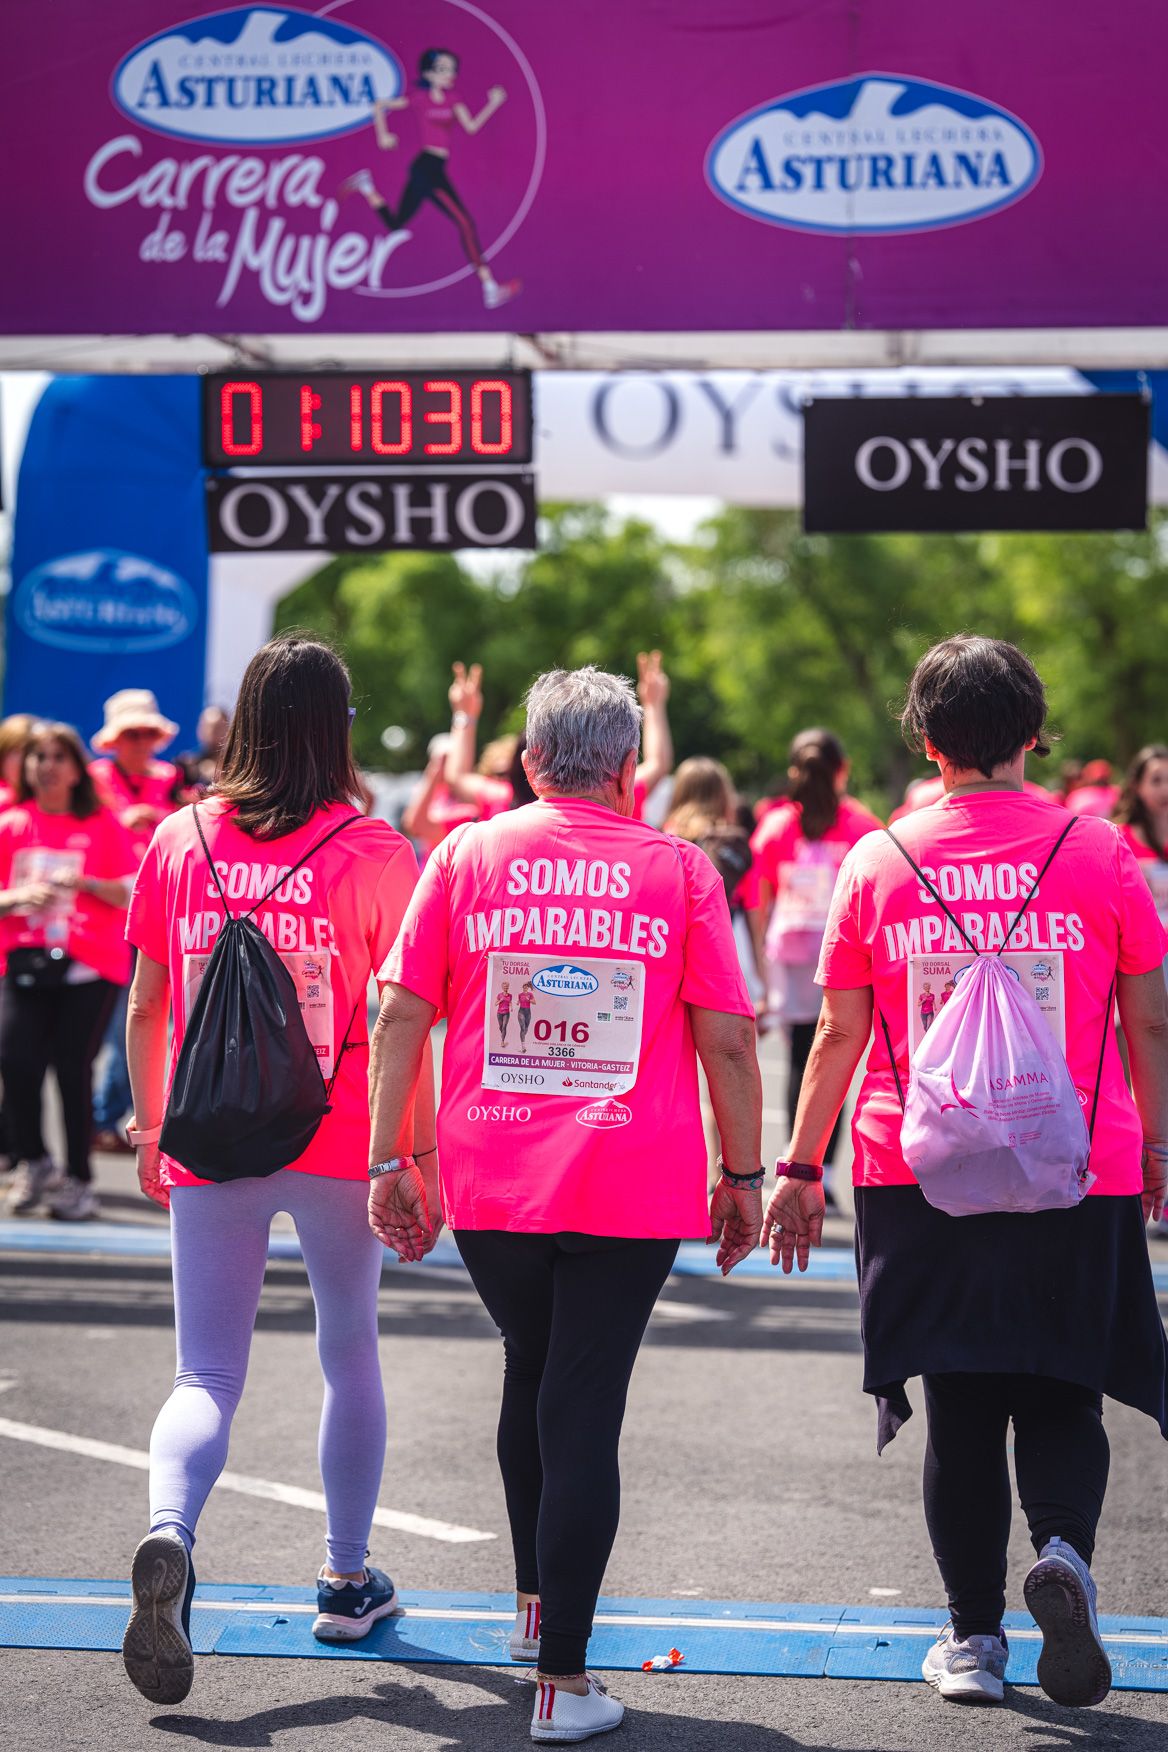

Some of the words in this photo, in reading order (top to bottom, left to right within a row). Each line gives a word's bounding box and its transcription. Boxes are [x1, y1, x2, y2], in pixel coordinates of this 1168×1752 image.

[136, 59, 381, 109] ASTURIANA
[783, 130, 885, 146] CENTRAL
[896, 127, 1004, 143] LECHERA
[84, 135, 326, 209] Carrera
[735, 136, 1013, 193] ASTURIANA
[140, 213, 187, 262] de
[194, 211, 229, 262] la
[217, 200, 412, 322] Mujer
[855, 436, 1102, 493] OYSHO
[219, 481, 525, 547] OYSHO
[206, 860, 314, 905] SOMOS
[506, 858, 632, 899] SOMOS
[916, 862, 1040, 904] SOMOS
[177, 909, 341, 957] IMPABLES
[465, 907, 669, 958] IMPARABLES
[882, 911, 1086, 962] IMPARABLES
[502, 967, 530, 976] SUMA
[537, 974, 594, 991] ASTURIANA
[923, 967, 951, 976] SUMA
[533, 1019, 590, 1044] 016
[548, 1046, 575, 1057] 3366
[491, 1056, 520, 1066] CARRERA
[520, 1058, 530, 1066] DE
[530, 1058, 540, 1067] LA
[541, 1060, 566, 1068] MUJER
[501, 1072, 545, 1085] OYSHO
[574, 1079, 618, 1090] Santander
[467, 1105, 532, 1122] OYSHO
